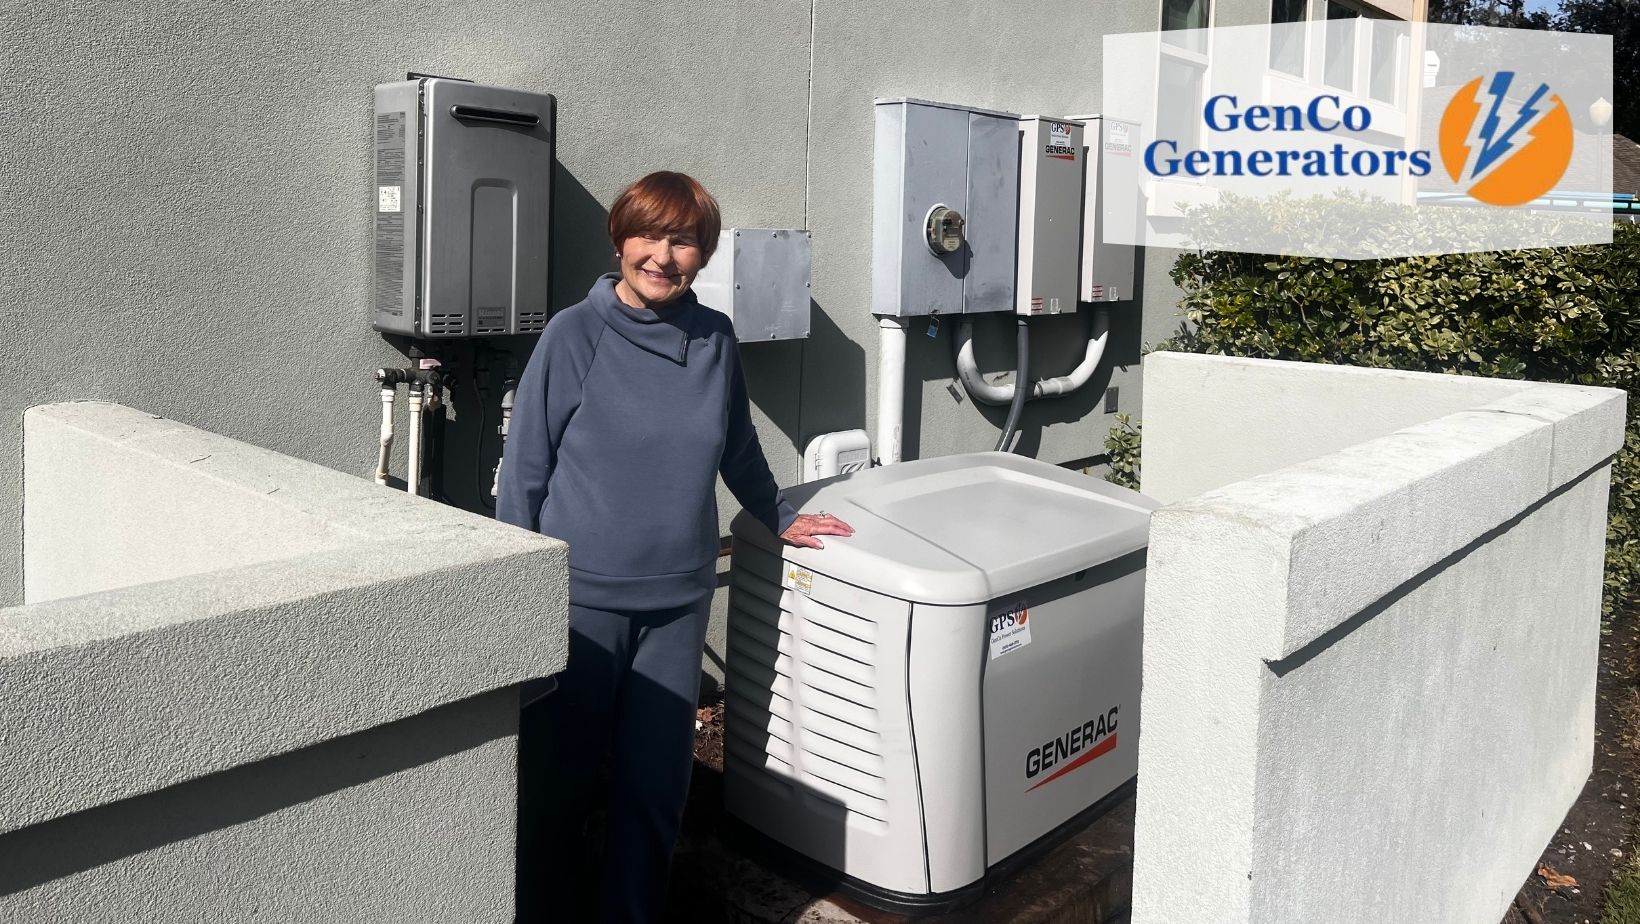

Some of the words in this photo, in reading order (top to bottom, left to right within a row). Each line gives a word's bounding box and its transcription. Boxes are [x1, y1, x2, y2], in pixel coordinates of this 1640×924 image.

[1051, 122, 1065, 133] GPS
[1045, 145, 1075, 155] GENERAC
[990, 610, 1015, 633] GPS
[1026, 706, 1118, 779] GENERAC
